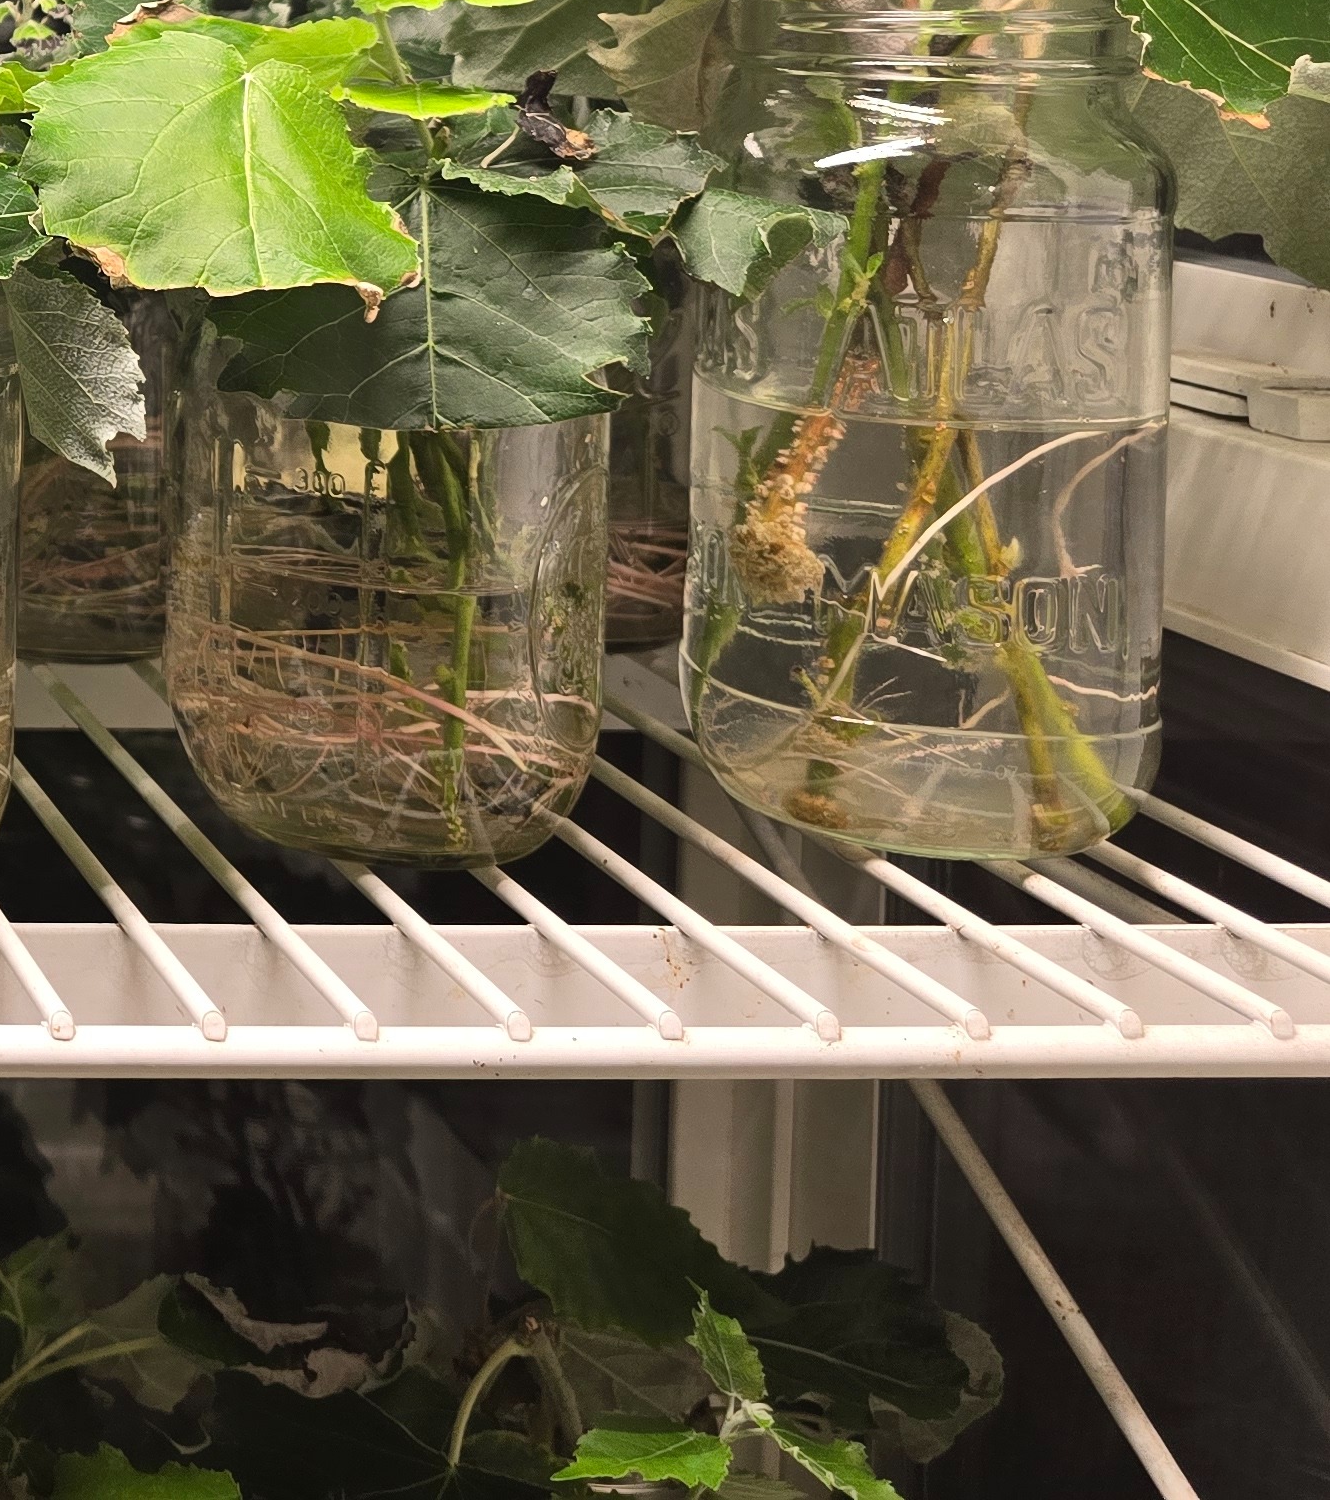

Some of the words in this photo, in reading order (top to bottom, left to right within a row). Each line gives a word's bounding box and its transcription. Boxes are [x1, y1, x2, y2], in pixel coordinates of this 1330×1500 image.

[826, 298, 1126, 406] ATLAS
[293, 466, 346, 498] 300
[814, 553, 1120, 653] MASON
